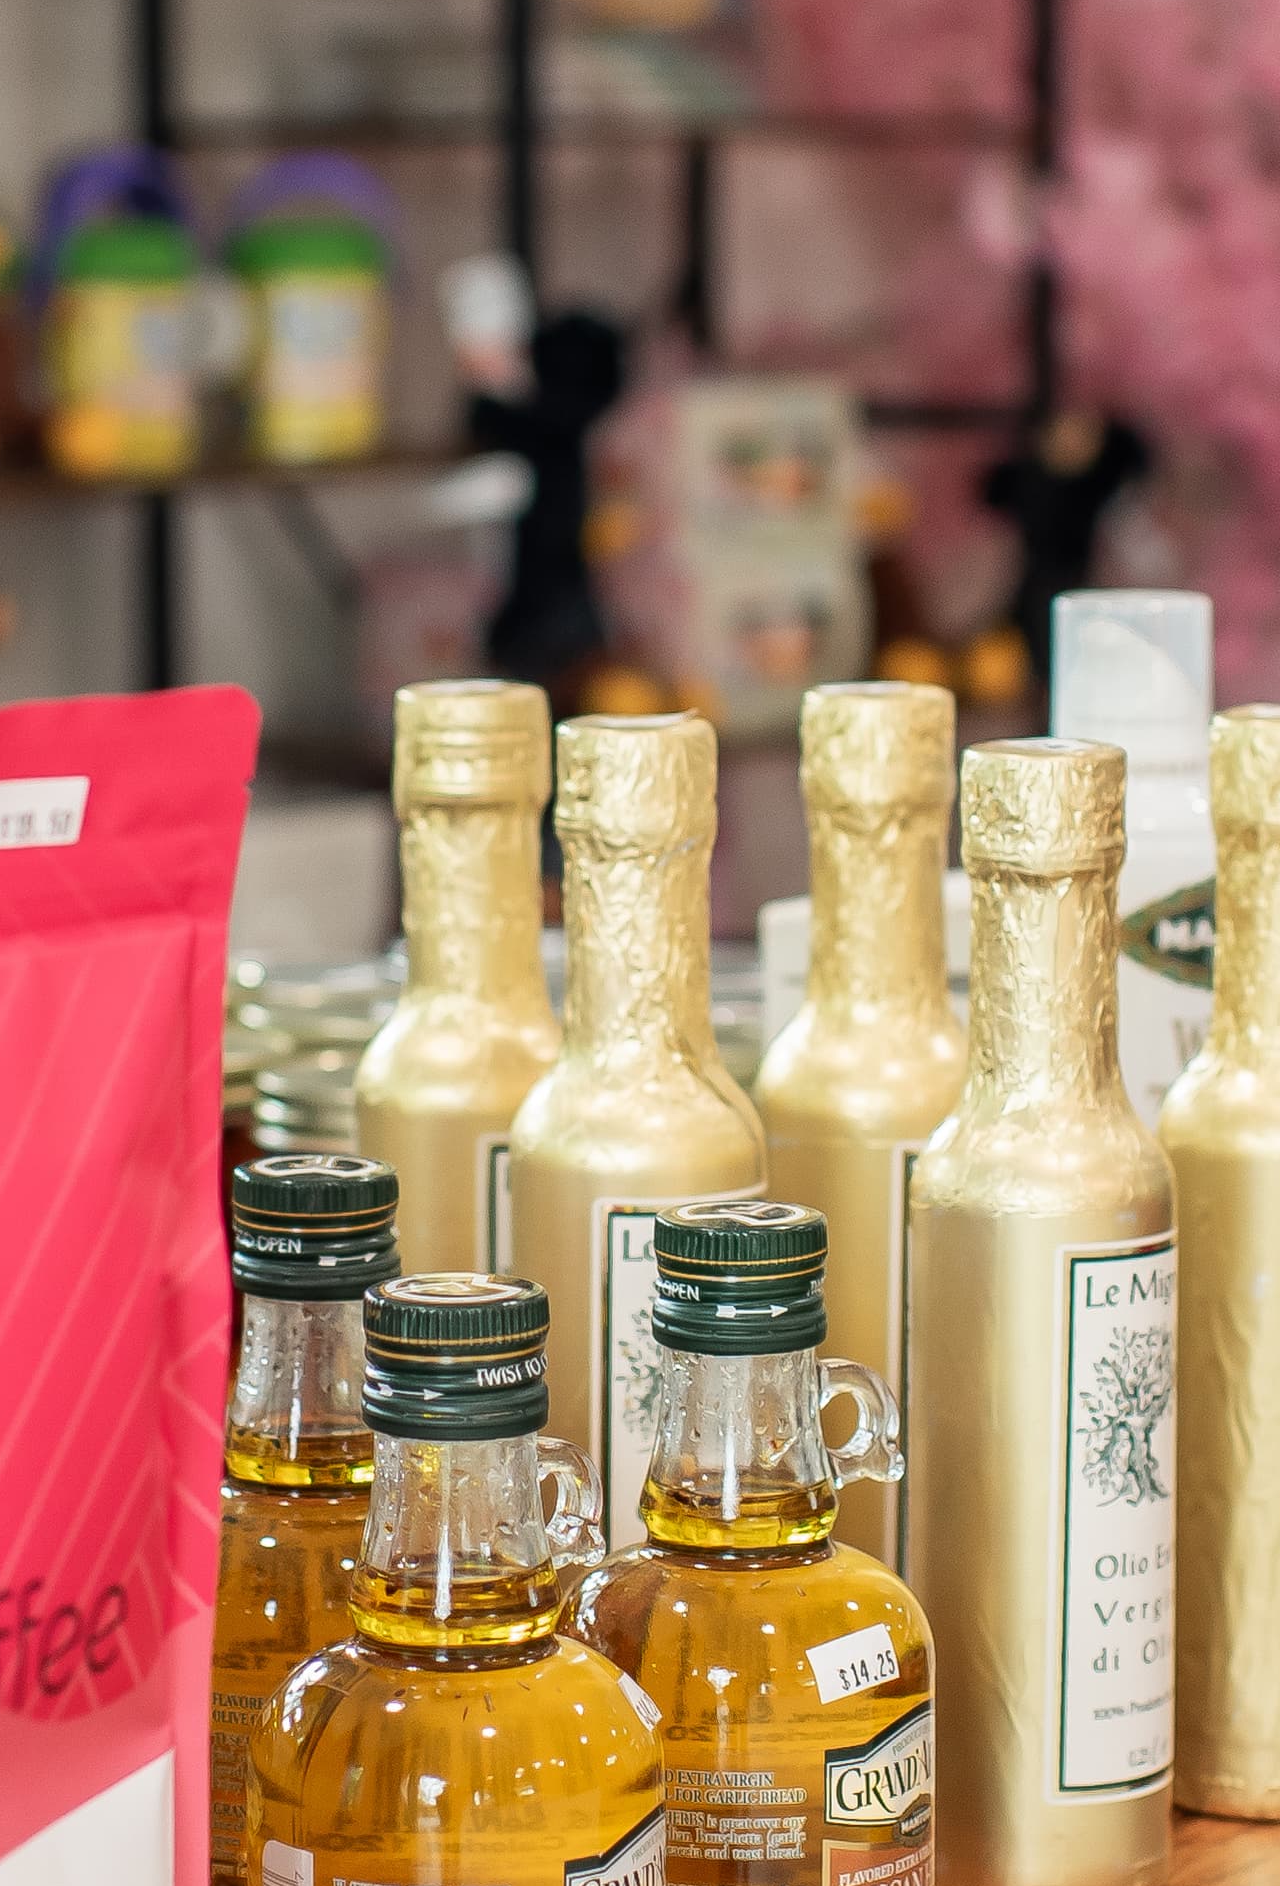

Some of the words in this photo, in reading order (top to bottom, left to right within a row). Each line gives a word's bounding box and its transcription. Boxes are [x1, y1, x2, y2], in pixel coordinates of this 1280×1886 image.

[258, 1237, 302, 1254] OPEN
[1086, 1272, 1120, 1310] Le
[477, 1362, 524, 1387] TWIST
[1094, 1551, 1148, 1583] Olio
[840, 1649, 896, 1692] $14.25
[1093, 1647, 1121, 1674] di
[678, 1769, 720, 1786] EXTRA
[724, 1771, 774, 1787] VIRGIN
[675, 1788, 702, 1803] FOR
[706, 1789, 758, 1804] GARLIC
[760, 1788, 807, 1804] BREAD
